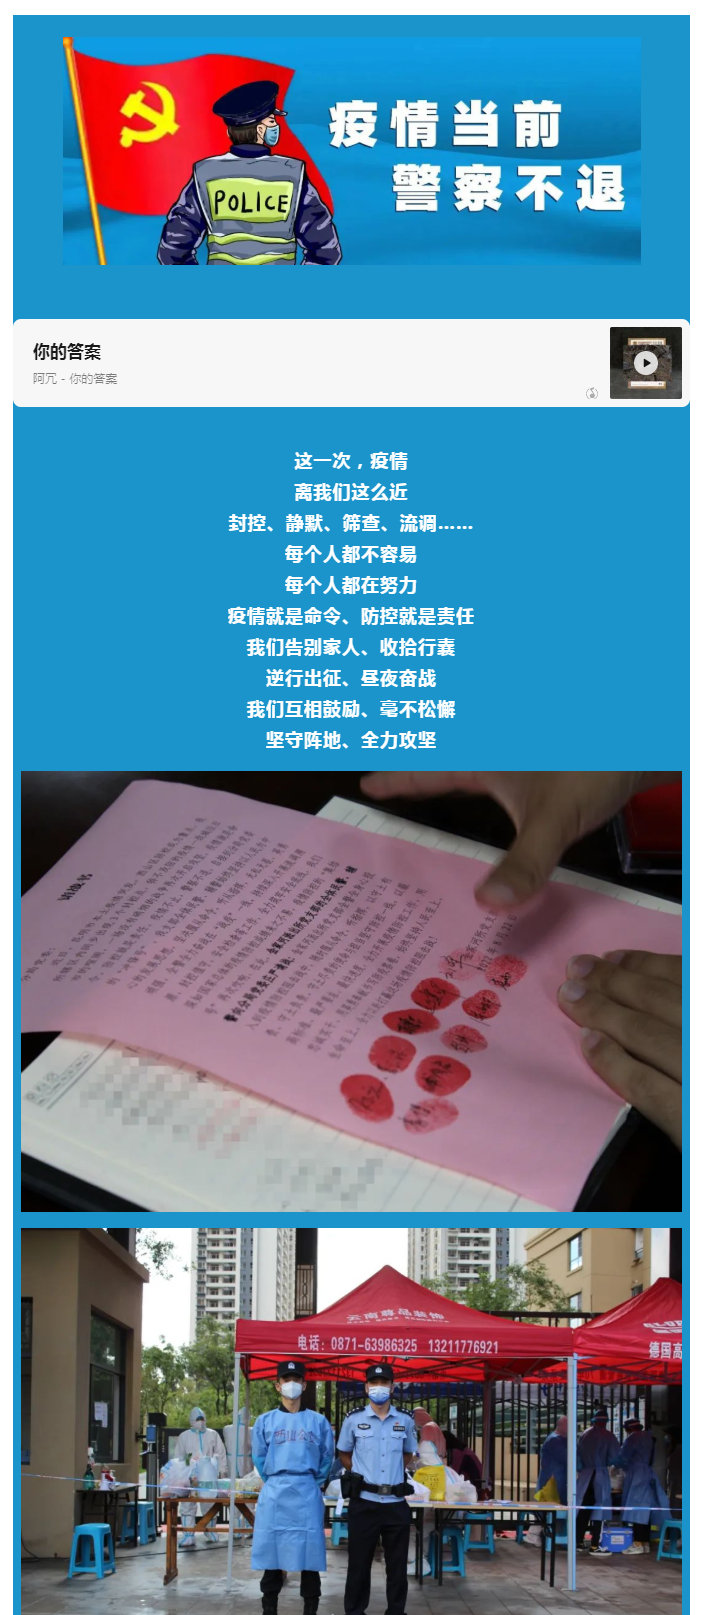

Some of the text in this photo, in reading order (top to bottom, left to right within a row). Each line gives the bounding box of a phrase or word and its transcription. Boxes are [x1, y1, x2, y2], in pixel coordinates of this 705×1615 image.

[328, 100, 563, 149] 疫情当前
[391, 164, 627, 213] 警察不退
[214, 187, 289, 216] POLICE
[33, 343, 101, 360] 你的答案
[33, 373, 57, 384] 阿冗
[69, 373, 117, 384] 你的答案
[295, 452, 408, 470] 这一次，疫情
[295, 483, 407, 501] 离我们这么近
[285, 545, 416, 563] 每个人都不容易
[285, 576, 416, 594] 每个人都在努力
[228, 607, 474, 625] 疫情就是命令、防控就是责任
[247, 638, 455, 656] 我们告别家人、收拾行囊
[266, 669, 436, 687] 逆行出征、昼夜奋战
[247, 700, 455, 718] 我们互相鼓励、毫不松懈
[266, 731, 436, 749] 坚守阵地、全力攻坚
[298, 1334, 500, 1354] 电话： 0871-63986325 13211776921
